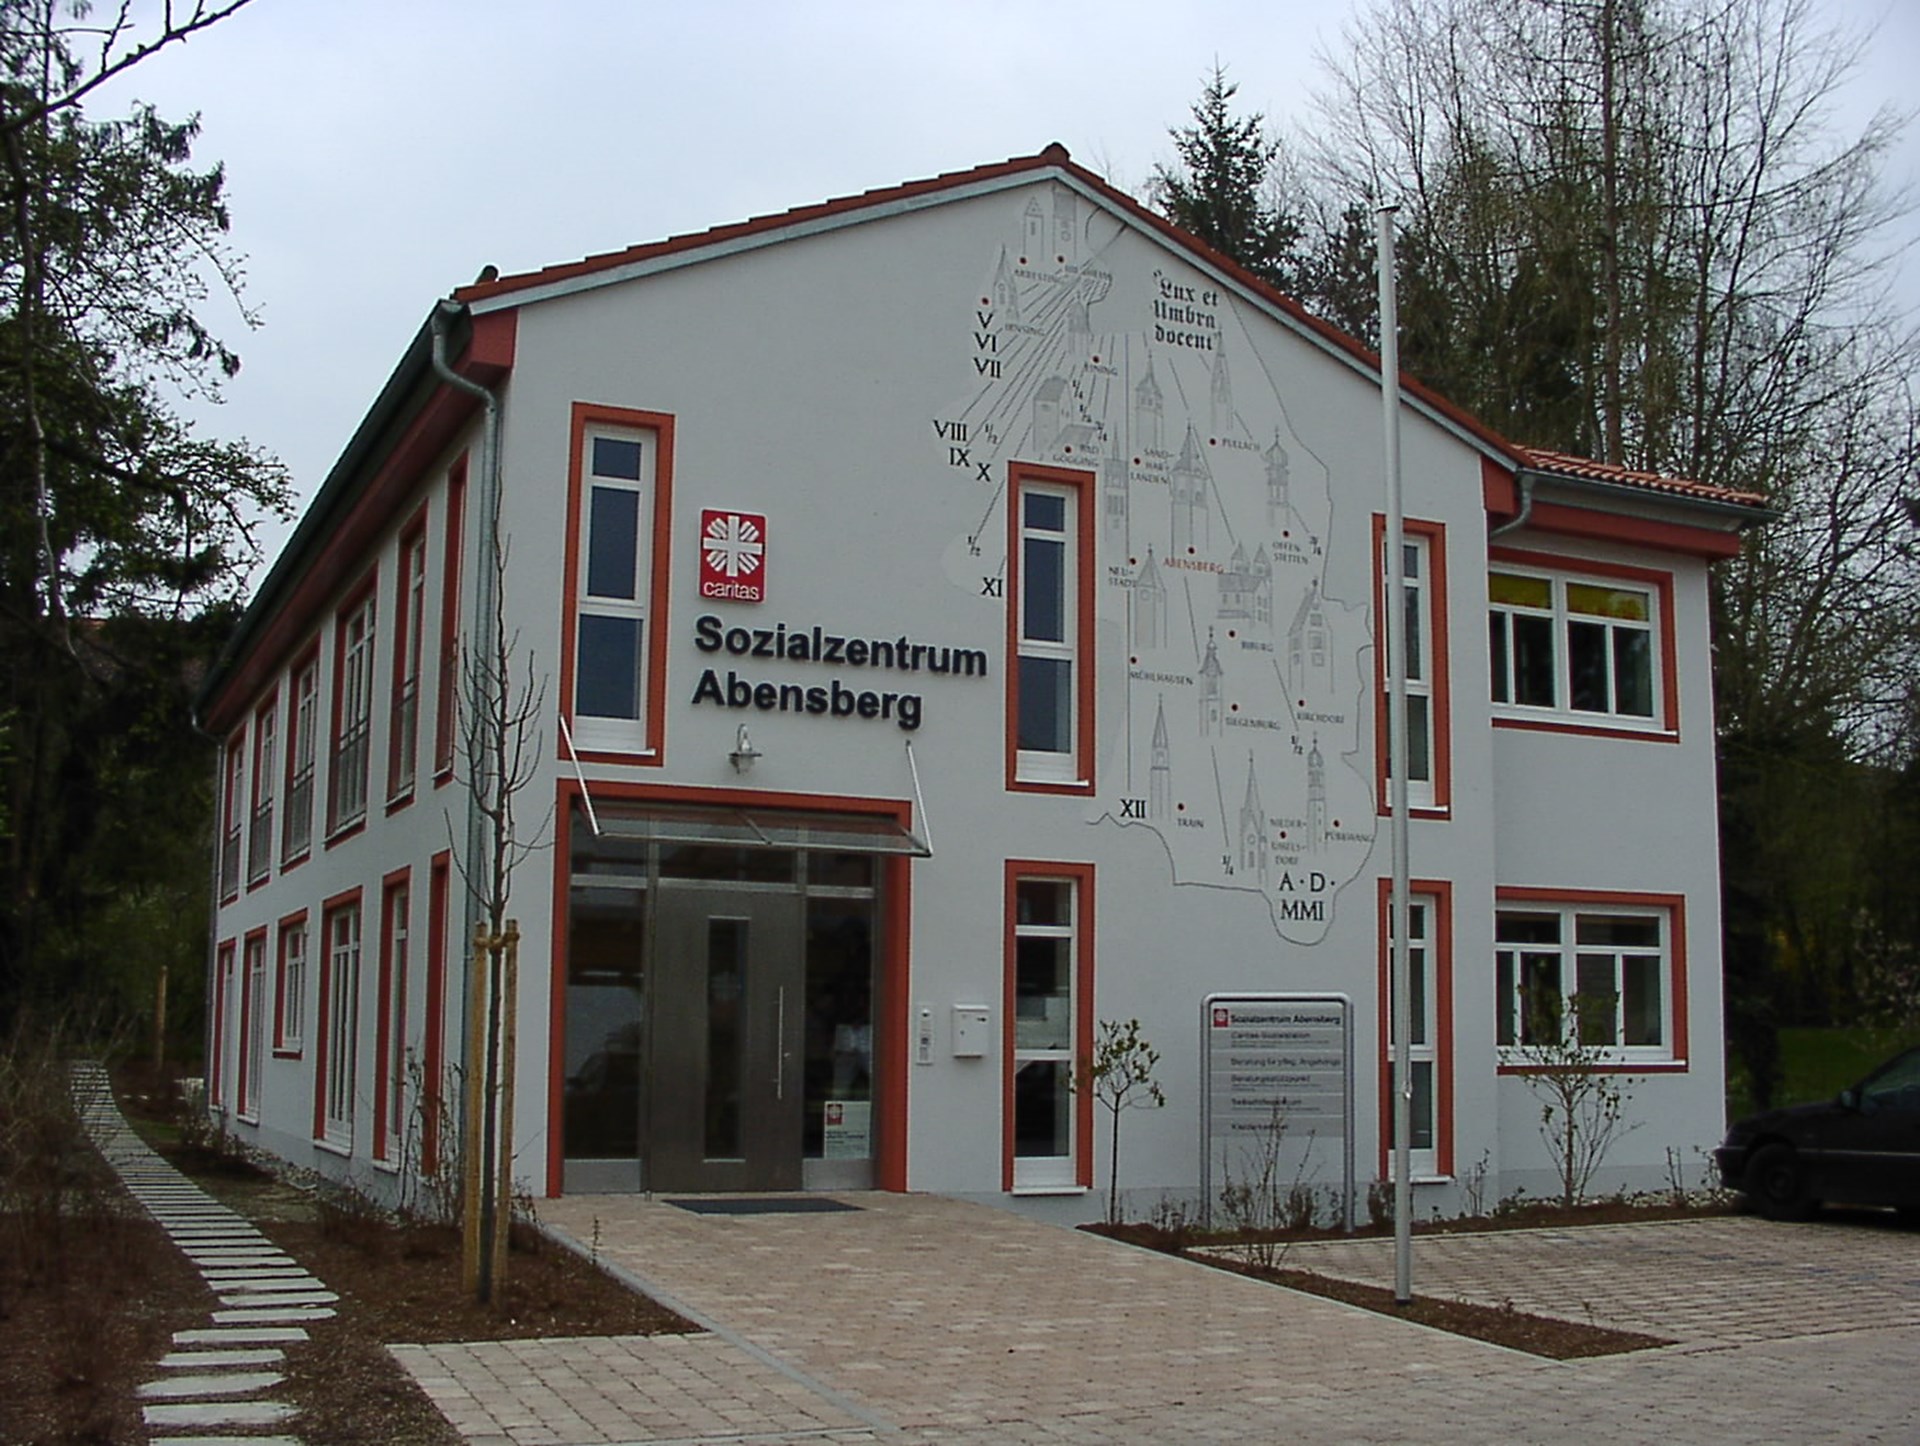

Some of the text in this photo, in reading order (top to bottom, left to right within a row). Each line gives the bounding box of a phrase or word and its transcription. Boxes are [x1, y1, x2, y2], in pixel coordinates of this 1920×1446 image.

[1202, 291, 1218, 307] et
[977, 311, 994, 329] V
[1153, 298, 1216, 329] Umbra
[973, 331, 997, 352] VI
[972, 356, 1001, 379] VII
[932, 419, 968, 442] VIII
[949, 446, 971, 468] IX
[975, 462, 992, 483] X
[1163, 557, 1224, 575] ABENSBERG
[703, 580, 760, 600] caritas
[981, 576, 1003, 598] XI
[694, 615, 987, 677] Sozialzentrum
[691, 668, 923, 730] Abensberg
[1120, 799, 1147, 819] XII
[1280, 899, 1324, 921] MMI
